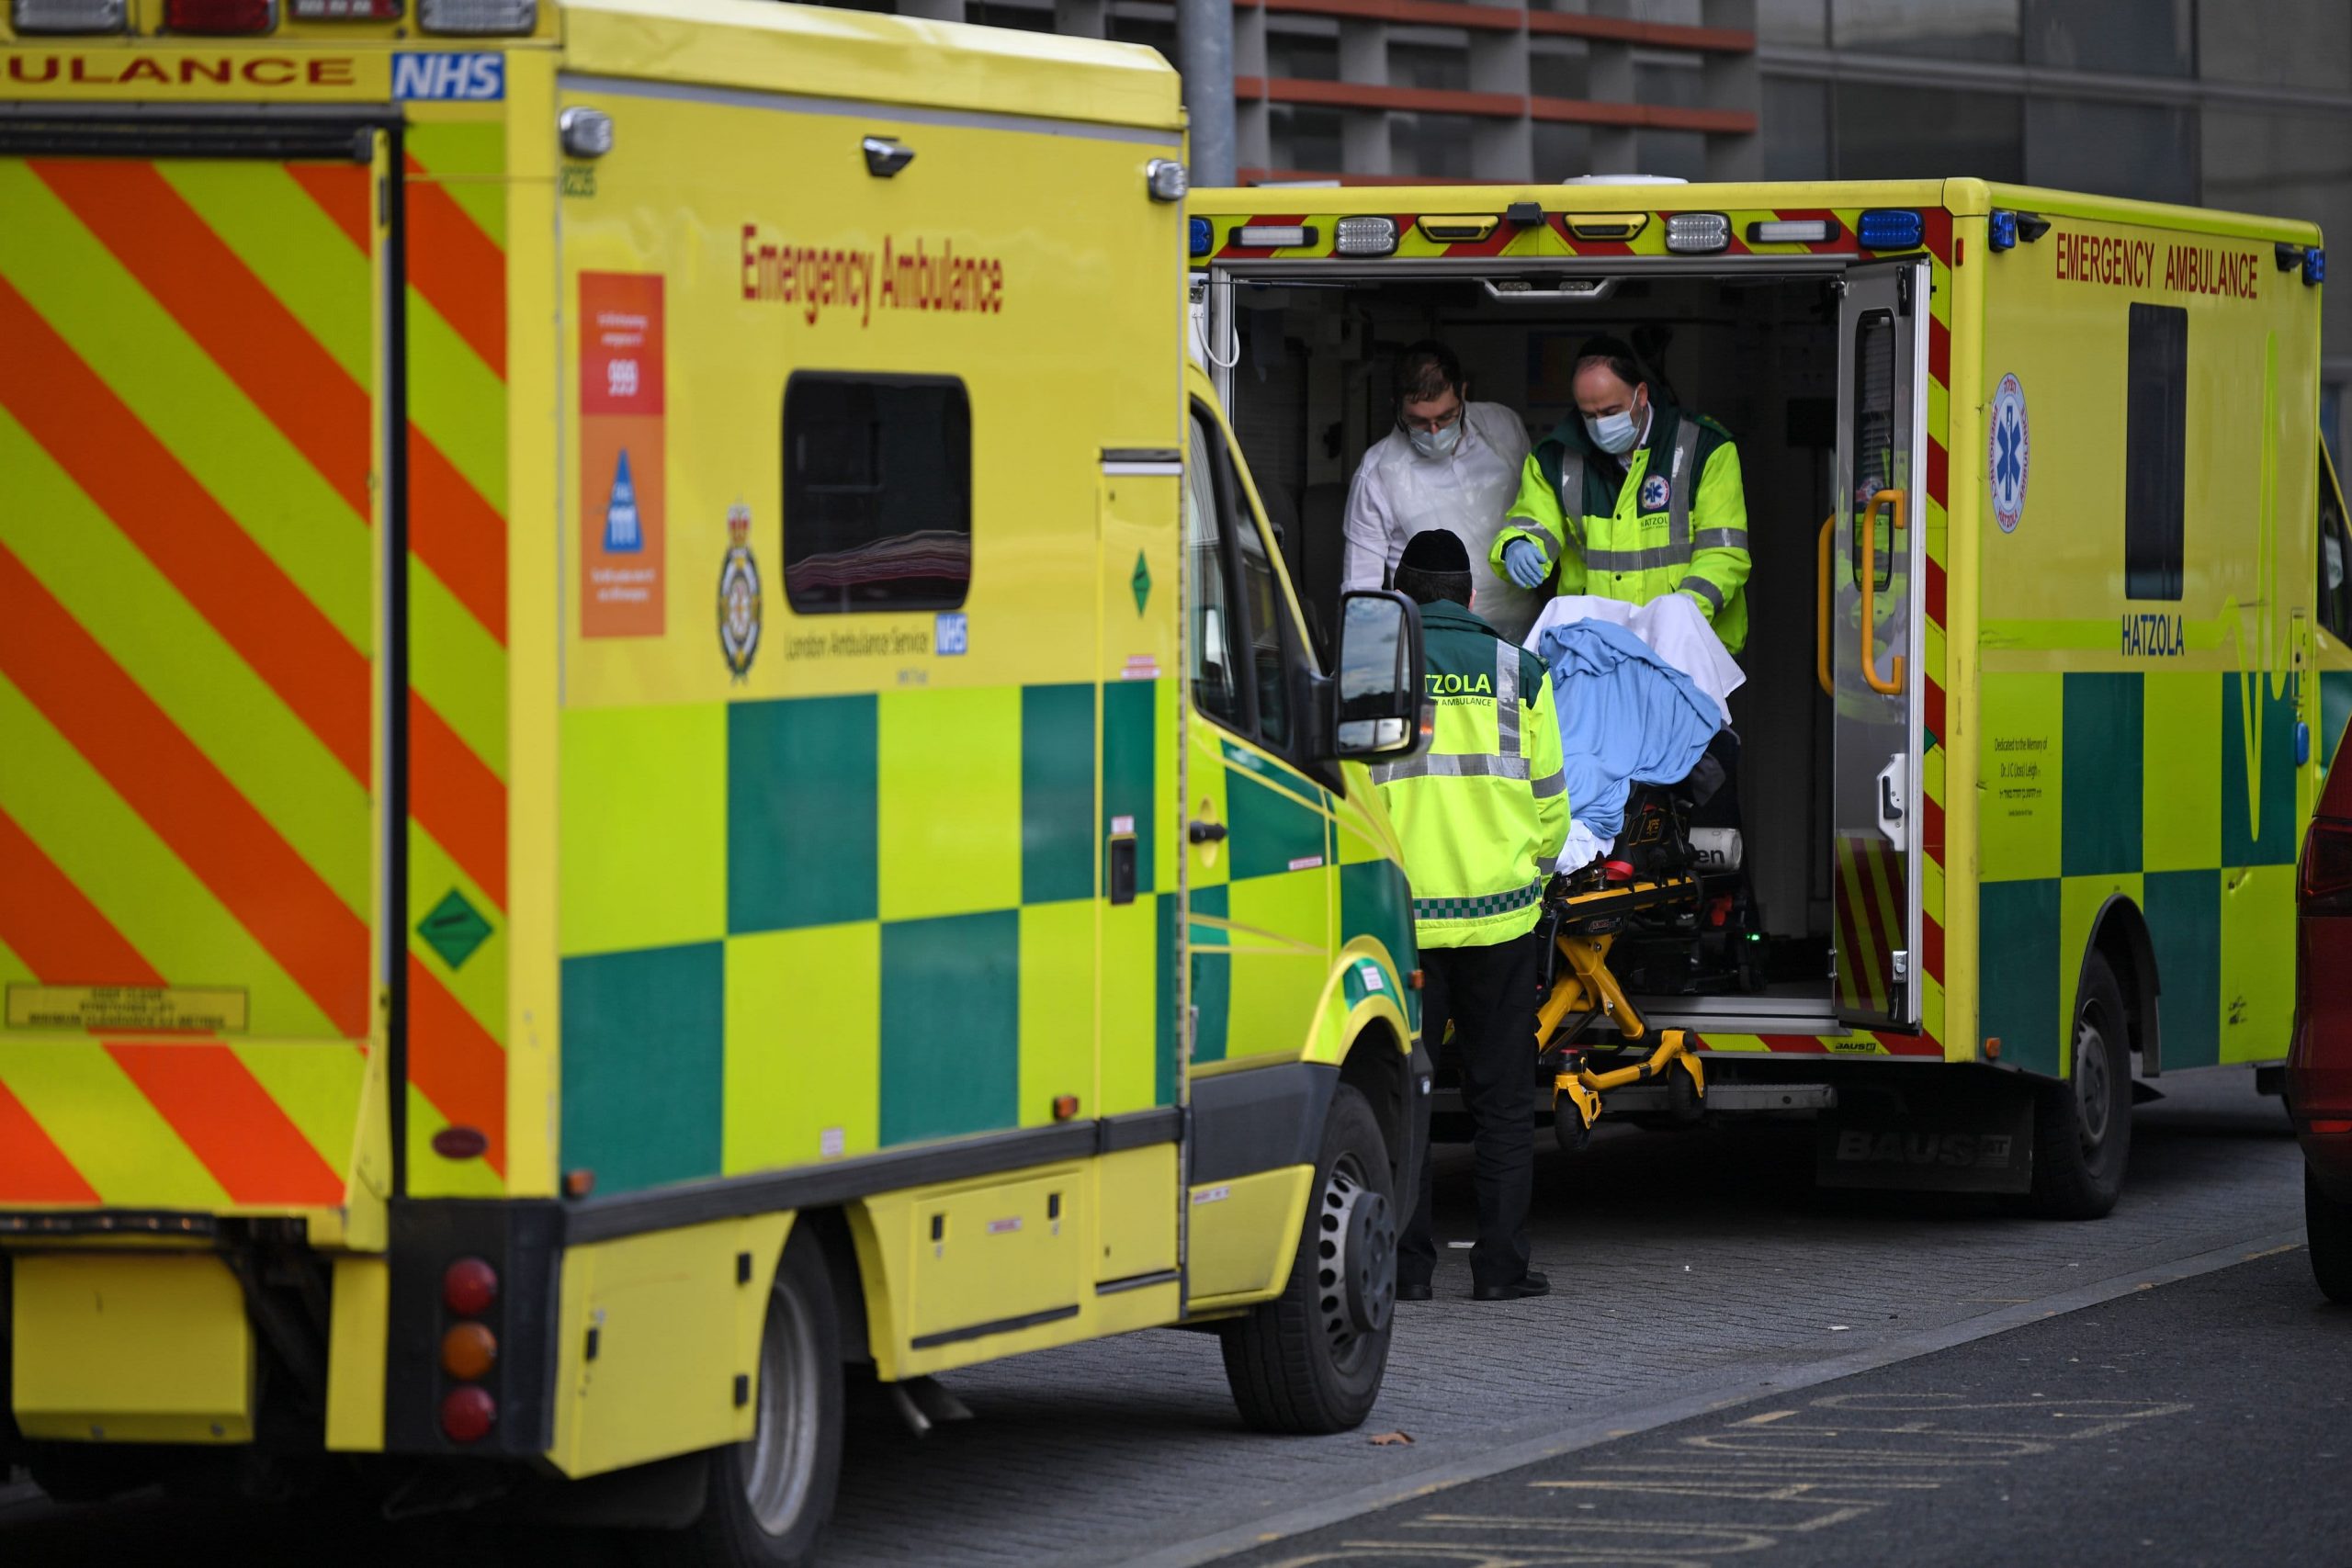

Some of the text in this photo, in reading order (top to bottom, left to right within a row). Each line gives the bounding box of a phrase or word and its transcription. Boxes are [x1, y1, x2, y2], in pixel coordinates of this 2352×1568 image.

[394, 54, 501, 98] NHS
[741, 223, 1003, 329] Emergency Ambulance
[2056, 232, 2258, 299] EMERGENCY AMBULANCE
[2122, 614, 2185, 656] HATZOLA
[1442, 697, 1492, 706] AMBULANCE
